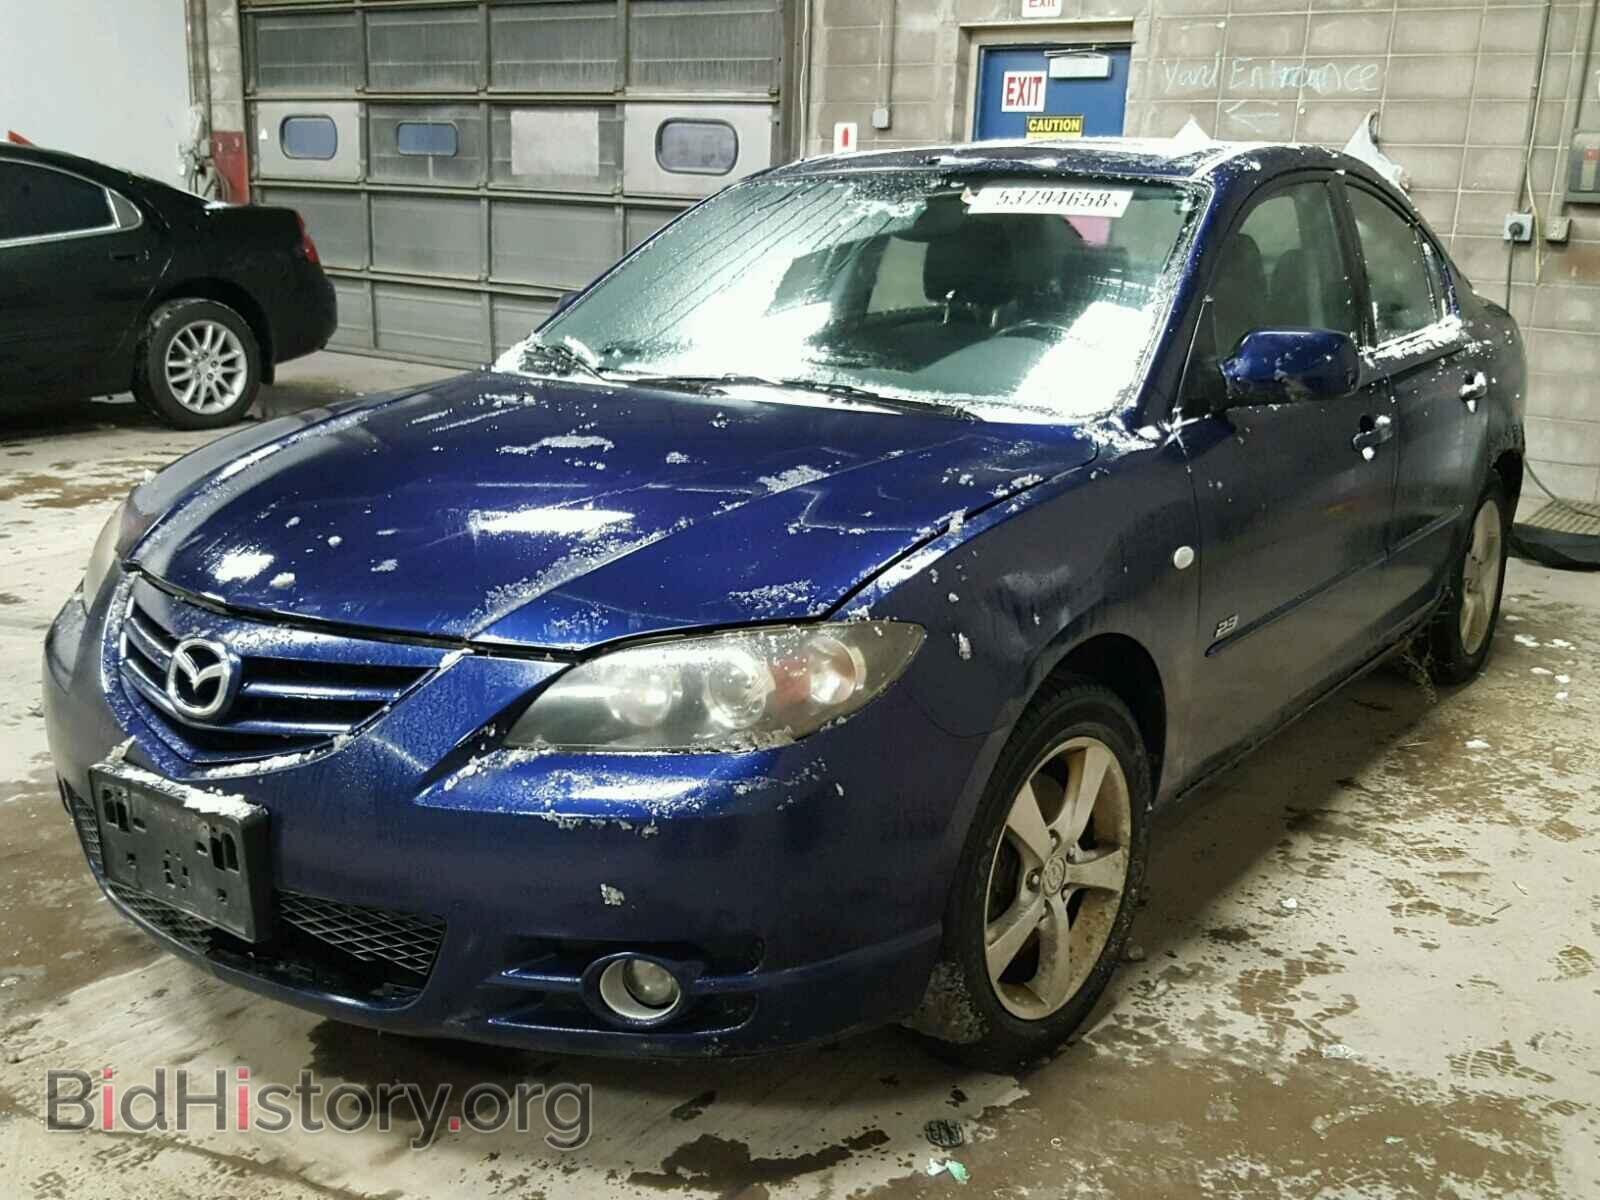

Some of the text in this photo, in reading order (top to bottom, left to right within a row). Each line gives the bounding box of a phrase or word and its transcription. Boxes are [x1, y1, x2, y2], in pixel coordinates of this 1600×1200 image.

[1163, 52, 1222, 93] Yard
[1006, 76, 1042, 106] EXIT
[1028, 118, 1080, 132] CAUTION
